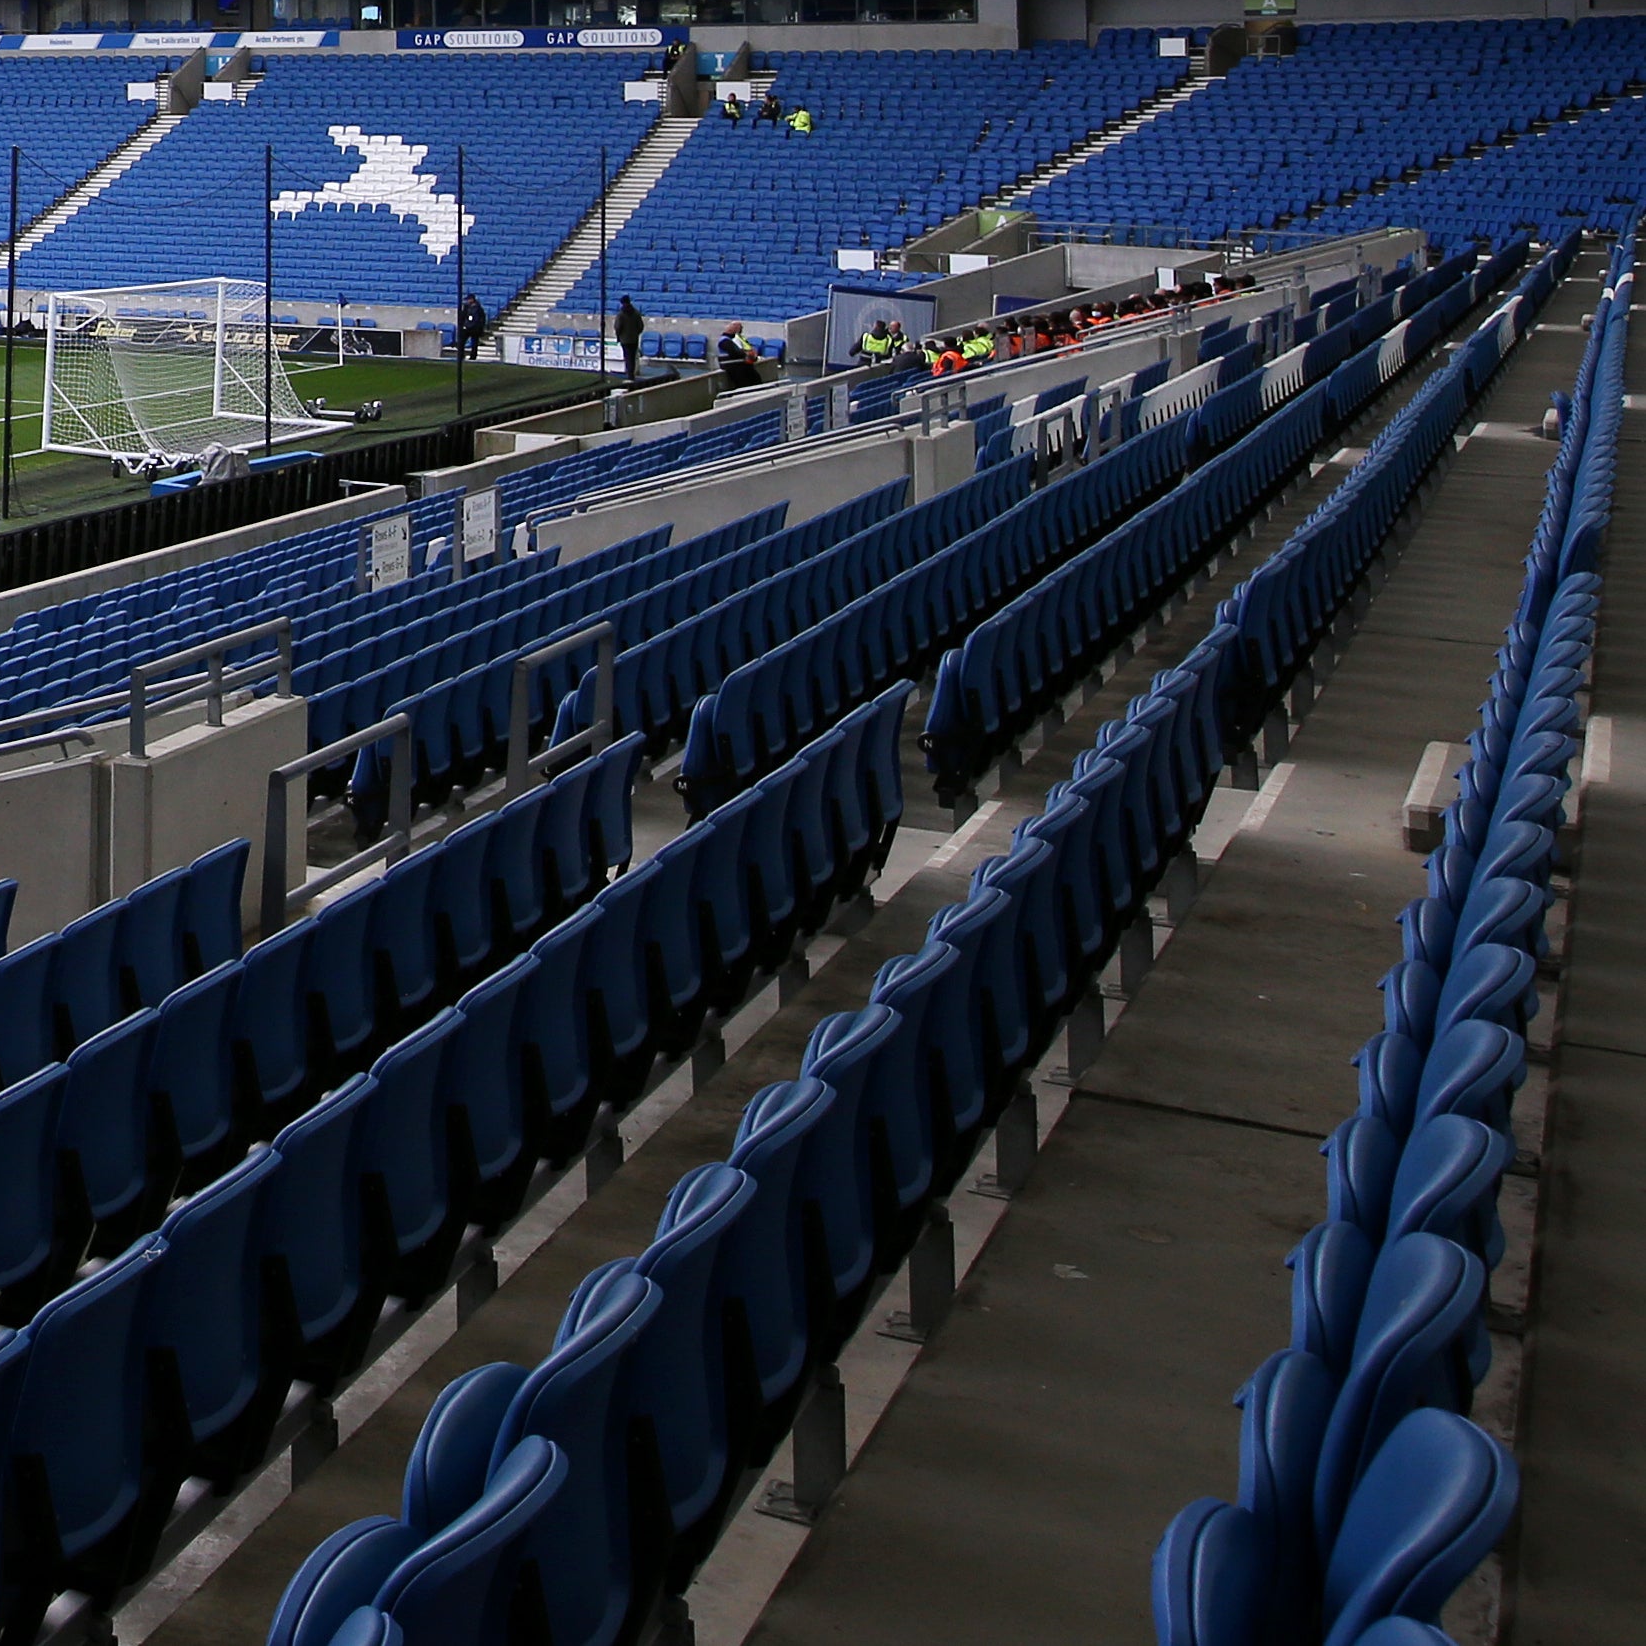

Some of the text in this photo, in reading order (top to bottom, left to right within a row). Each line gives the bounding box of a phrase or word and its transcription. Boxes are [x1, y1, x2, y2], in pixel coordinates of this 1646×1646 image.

[415, 30, 657, 46] GAP SOLUTIONS GAP SOLUTIONS
[996, 213, 1008, 227] A
